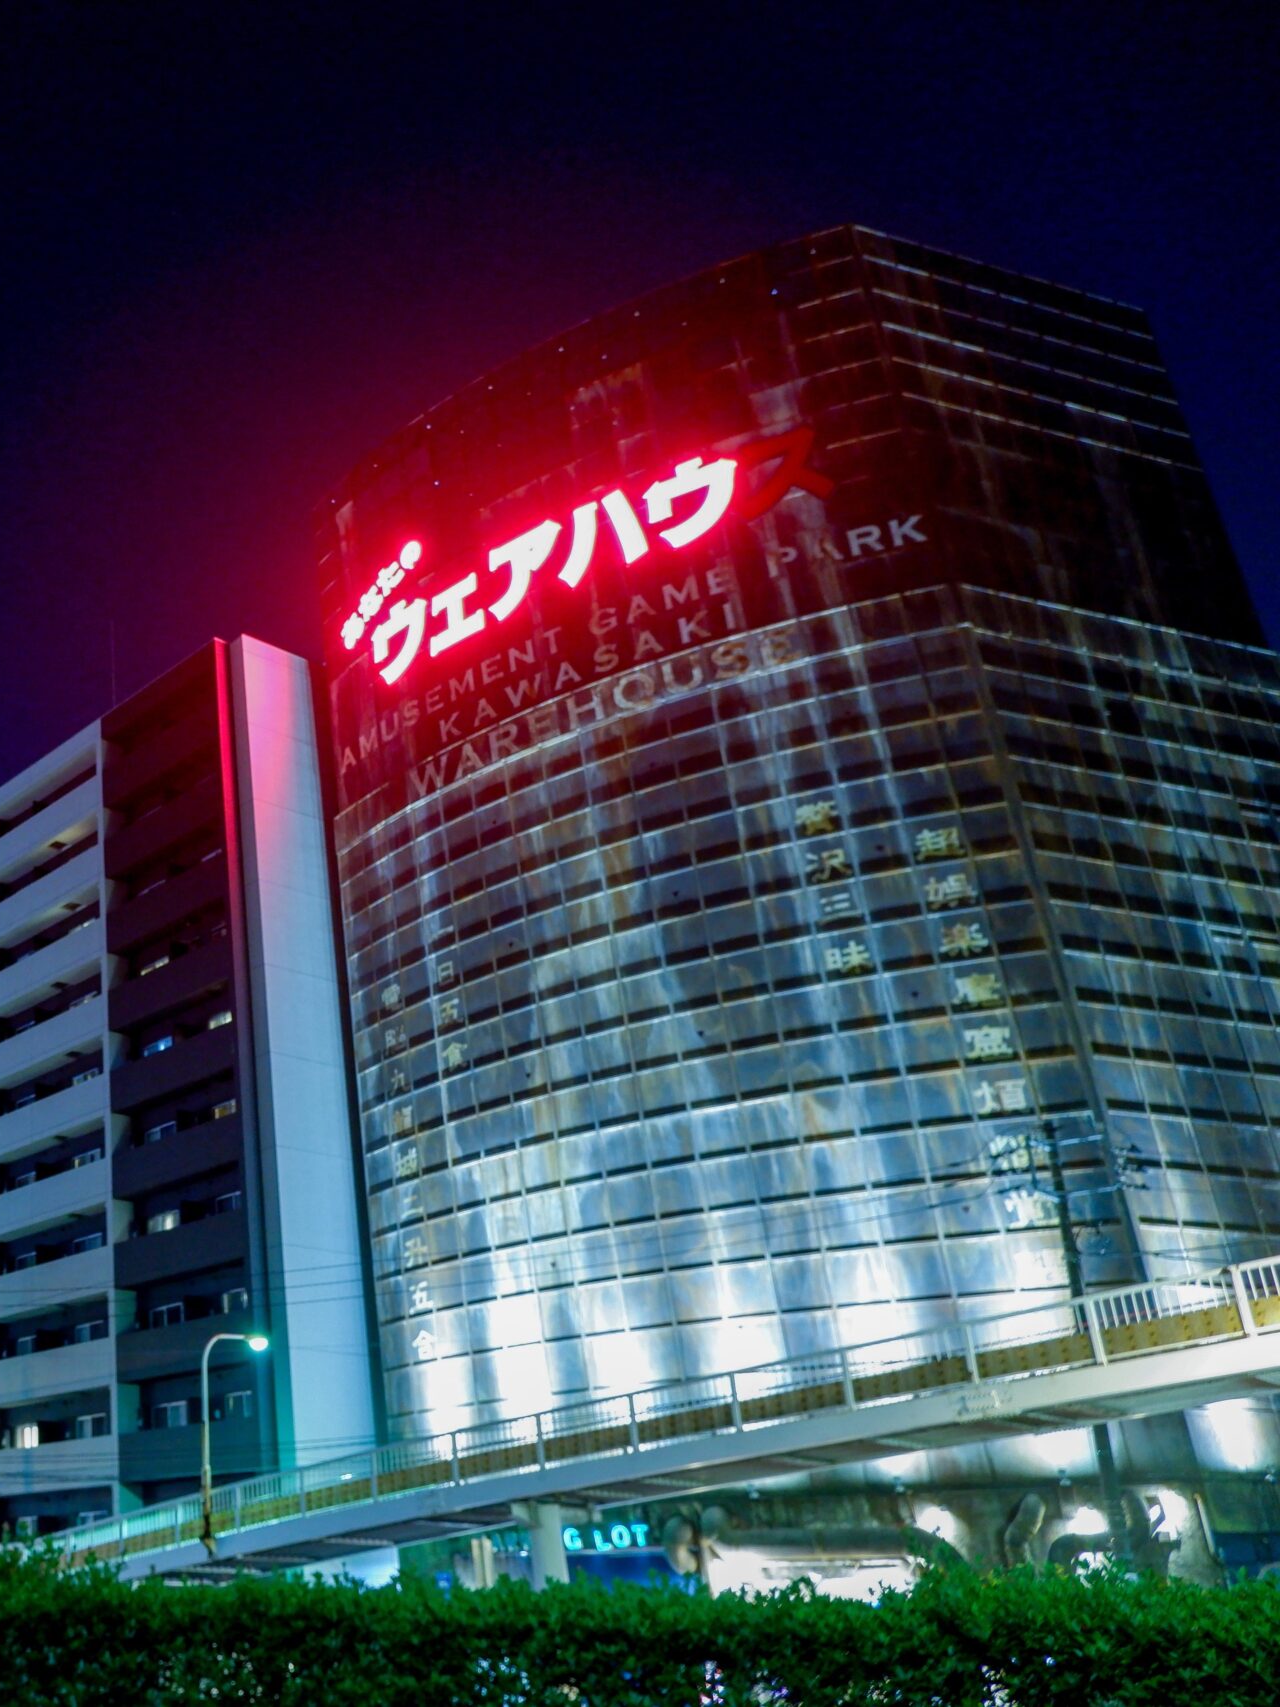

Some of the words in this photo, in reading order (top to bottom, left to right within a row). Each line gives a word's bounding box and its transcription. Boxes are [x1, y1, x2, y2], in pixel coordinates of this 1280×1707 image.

[341, 626, 562, 776] AMUSEMENT
[588, 566, 732, 637] GAME
[766, 514, 928, 579] PARK
[409, 625, 800, 798] WAREHOUSE
[438, 602, 737, 743] KAWASAKI
[593, 1523, 649, 1551] LOT
